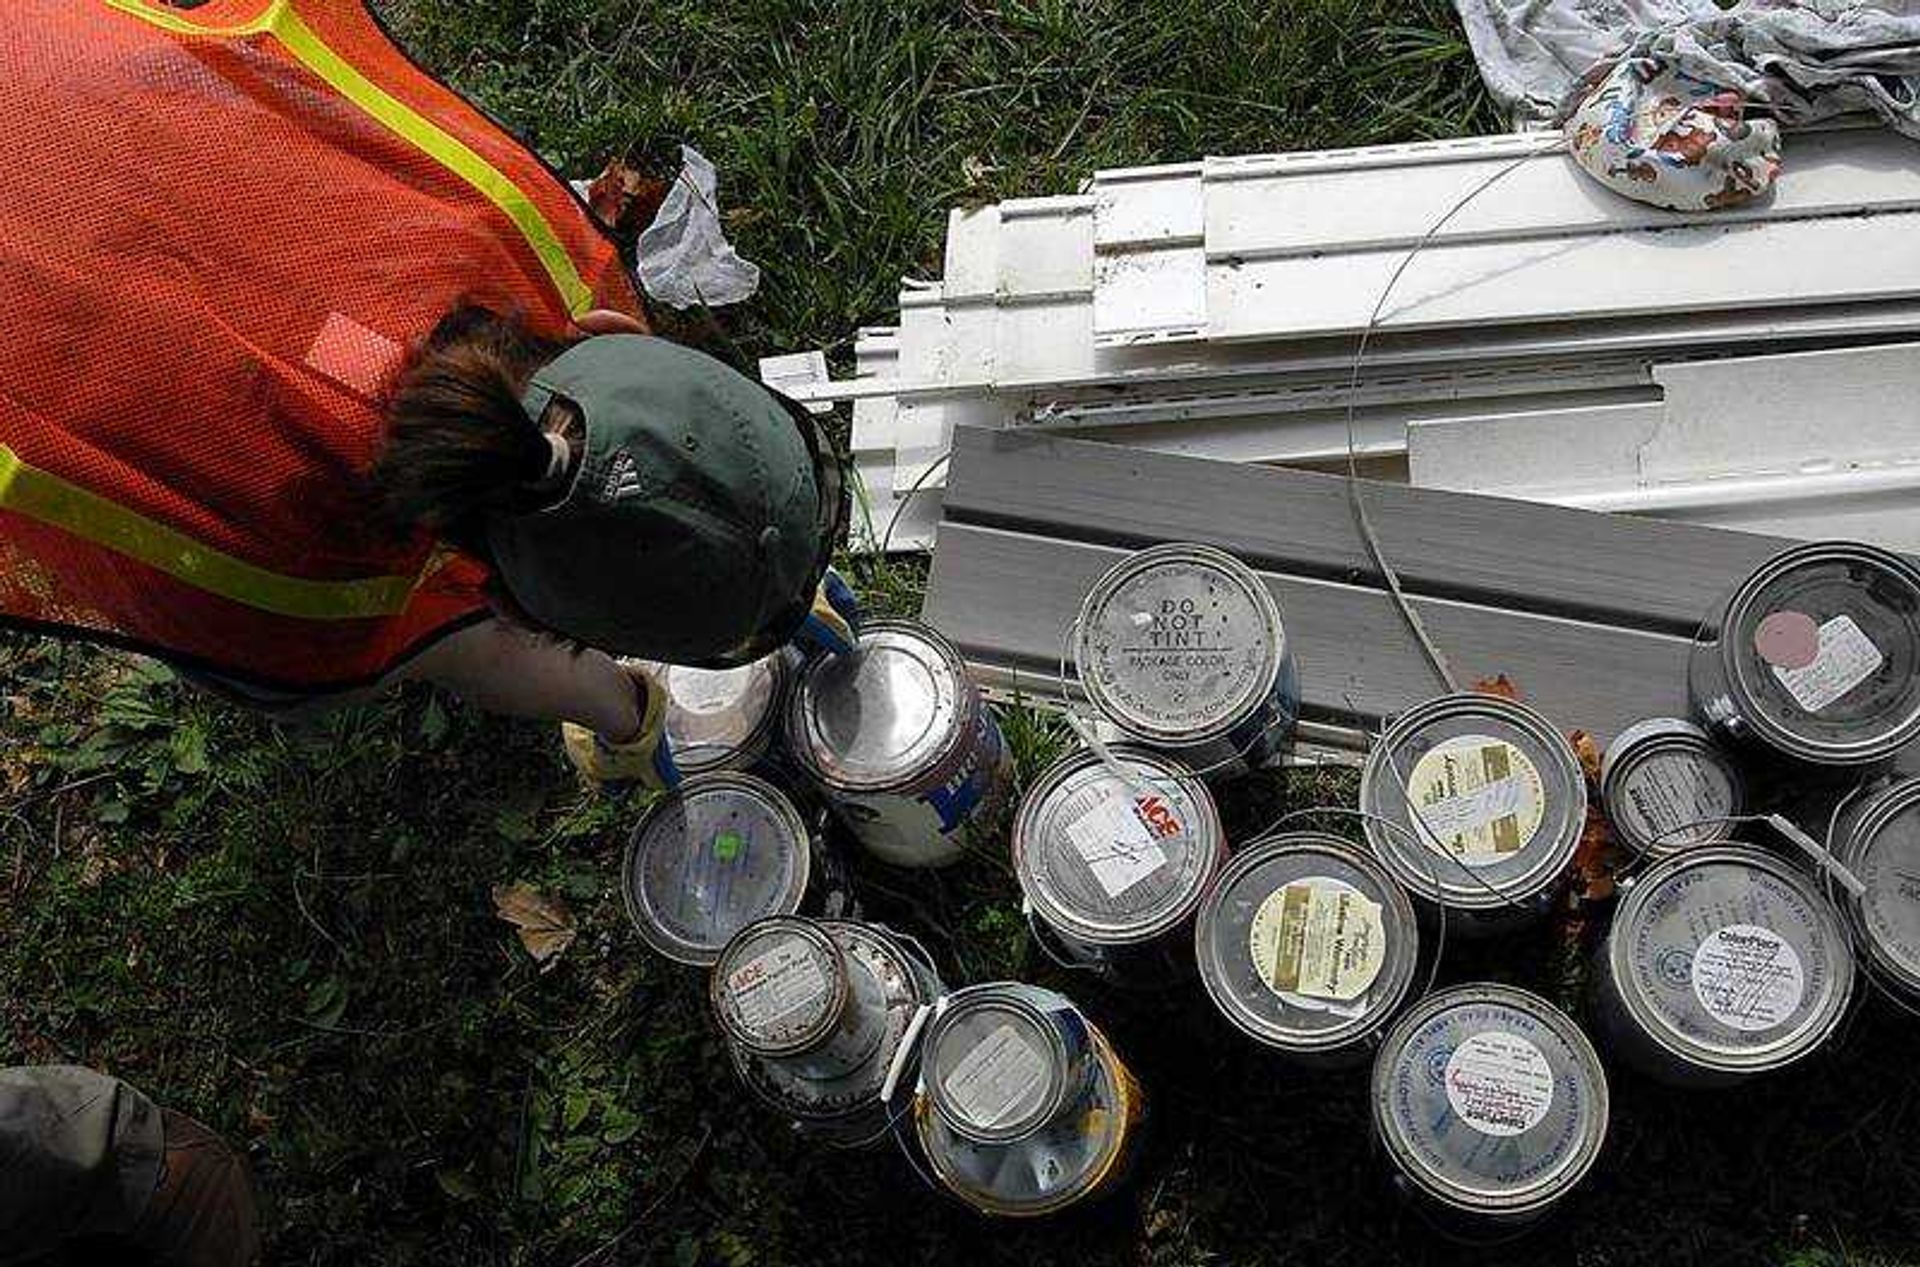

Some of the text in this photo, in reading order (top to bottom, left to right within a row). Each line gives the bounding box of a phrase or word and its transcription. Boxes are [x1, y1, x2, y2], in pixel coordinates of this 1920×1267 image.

[1162, 599, 1194, 613] DO
[1155, 614, 1204, 630] NOT
[1150, 631, 1206, 646] TINT
[1134, 797, 1180, 838] ACE
